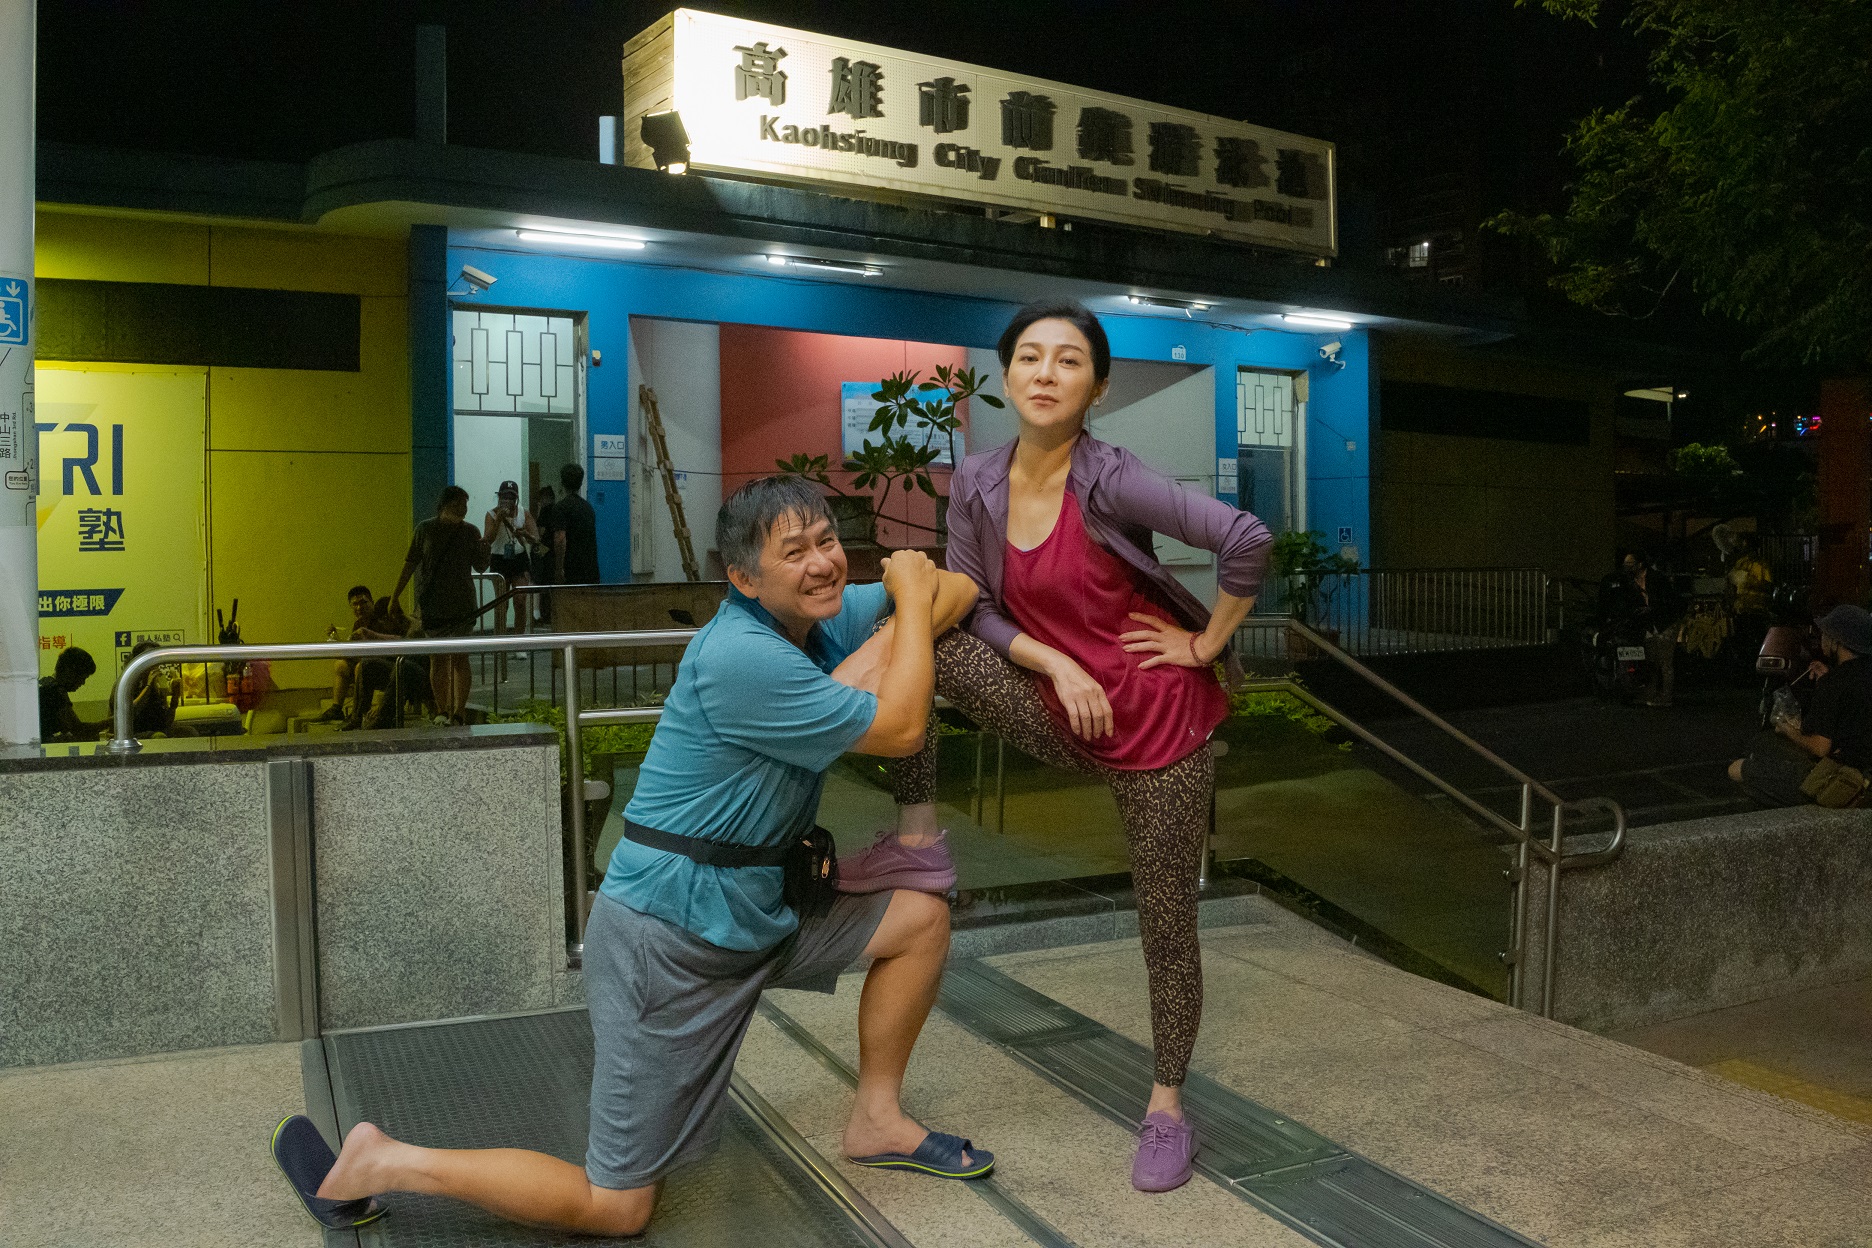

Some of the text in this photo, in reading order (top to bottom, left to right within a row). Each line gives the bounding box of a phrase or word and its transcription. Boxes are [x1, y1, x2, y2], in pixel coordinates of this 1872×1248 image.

[760, 114, 919, 168] Kaohsiung
[933, 142, 1001, 181] City
[0, 412, 11, 459] 中山三路
[78, 507, 126, 552] 塾
[38, 595, 105, 612] 出你極限
